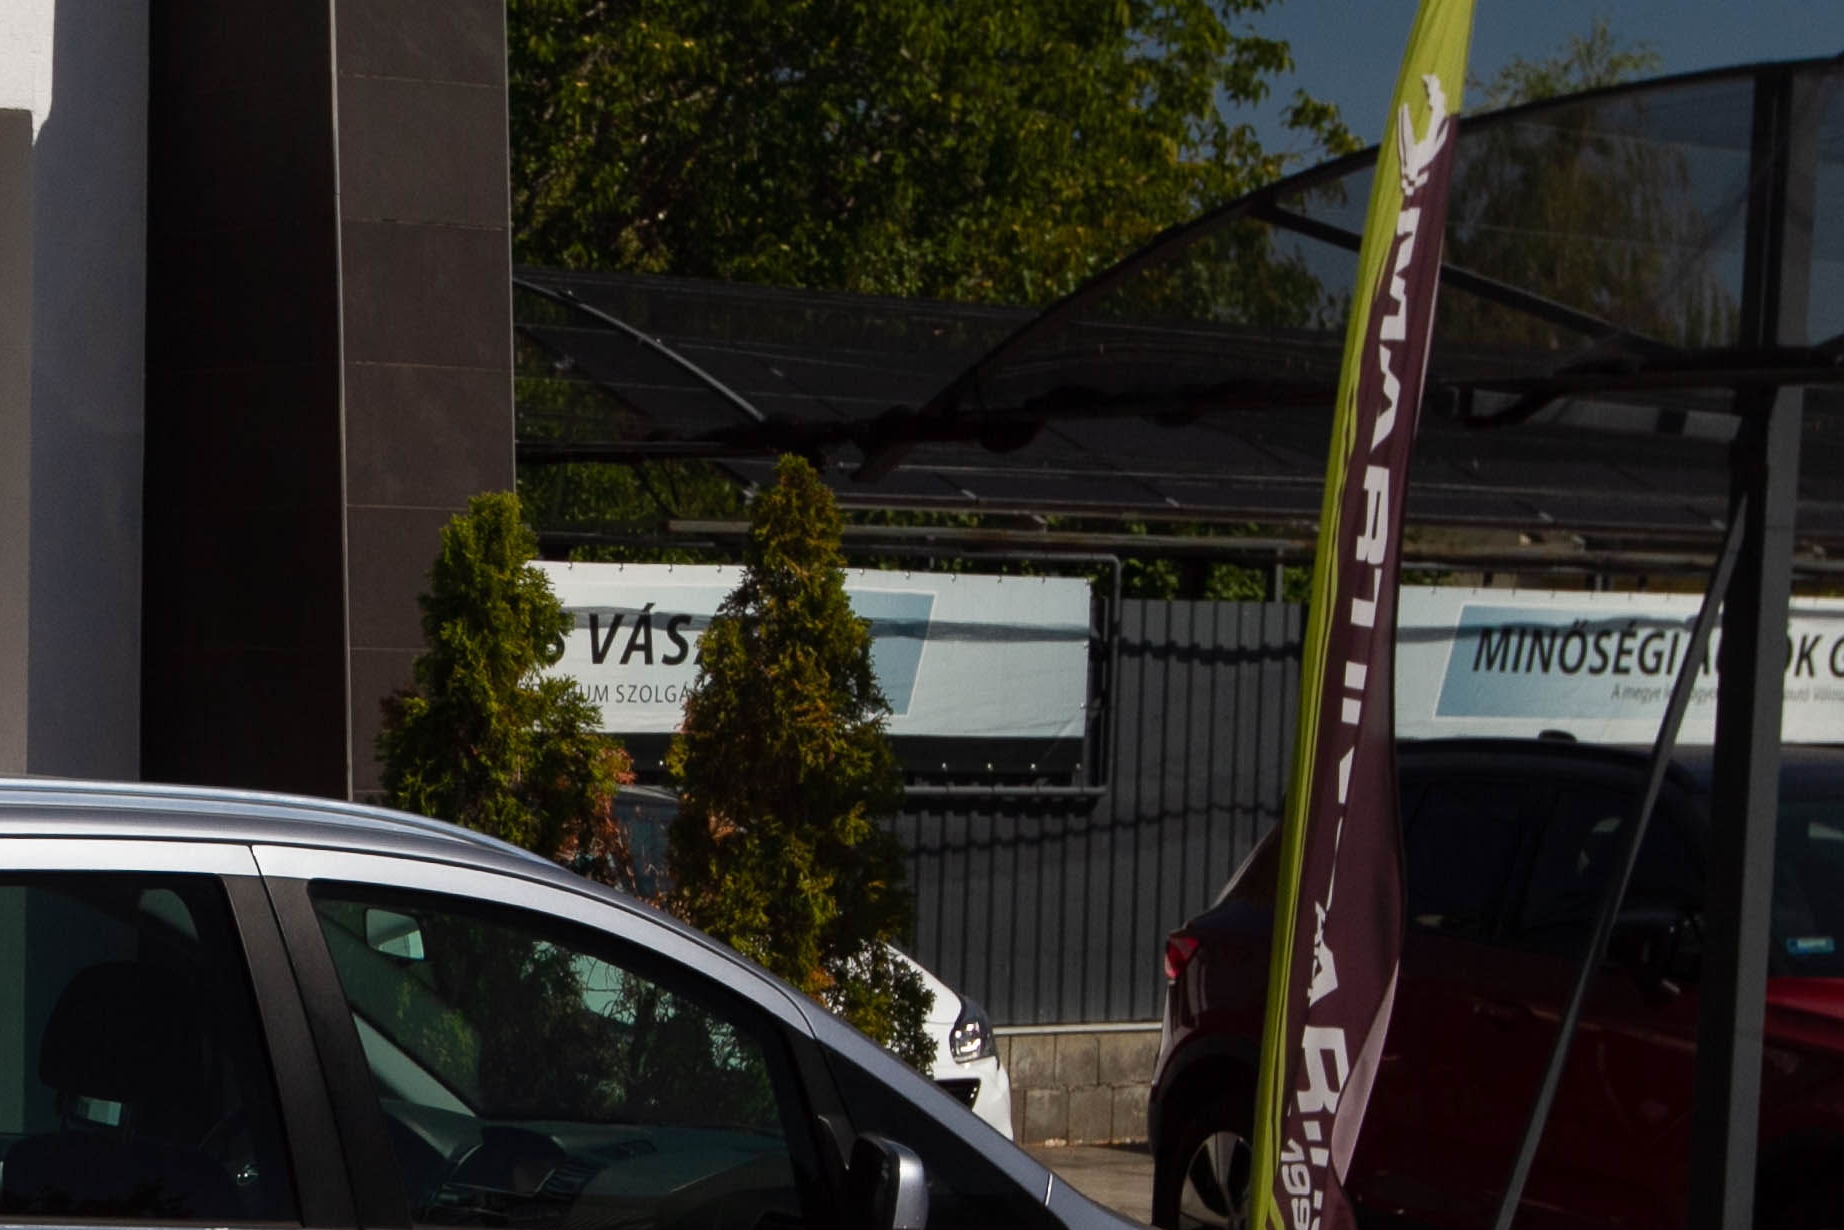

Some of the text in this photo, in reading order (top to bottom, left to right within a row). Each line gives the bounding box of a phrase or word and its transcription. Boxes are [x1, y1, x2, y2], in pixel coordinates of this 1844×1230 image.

[589, 602, 704, 666] VÁS
[1473, 618, 1679, 676] MINŐSÉGI
[615, 681, 692, 704] SZOLGÁ
